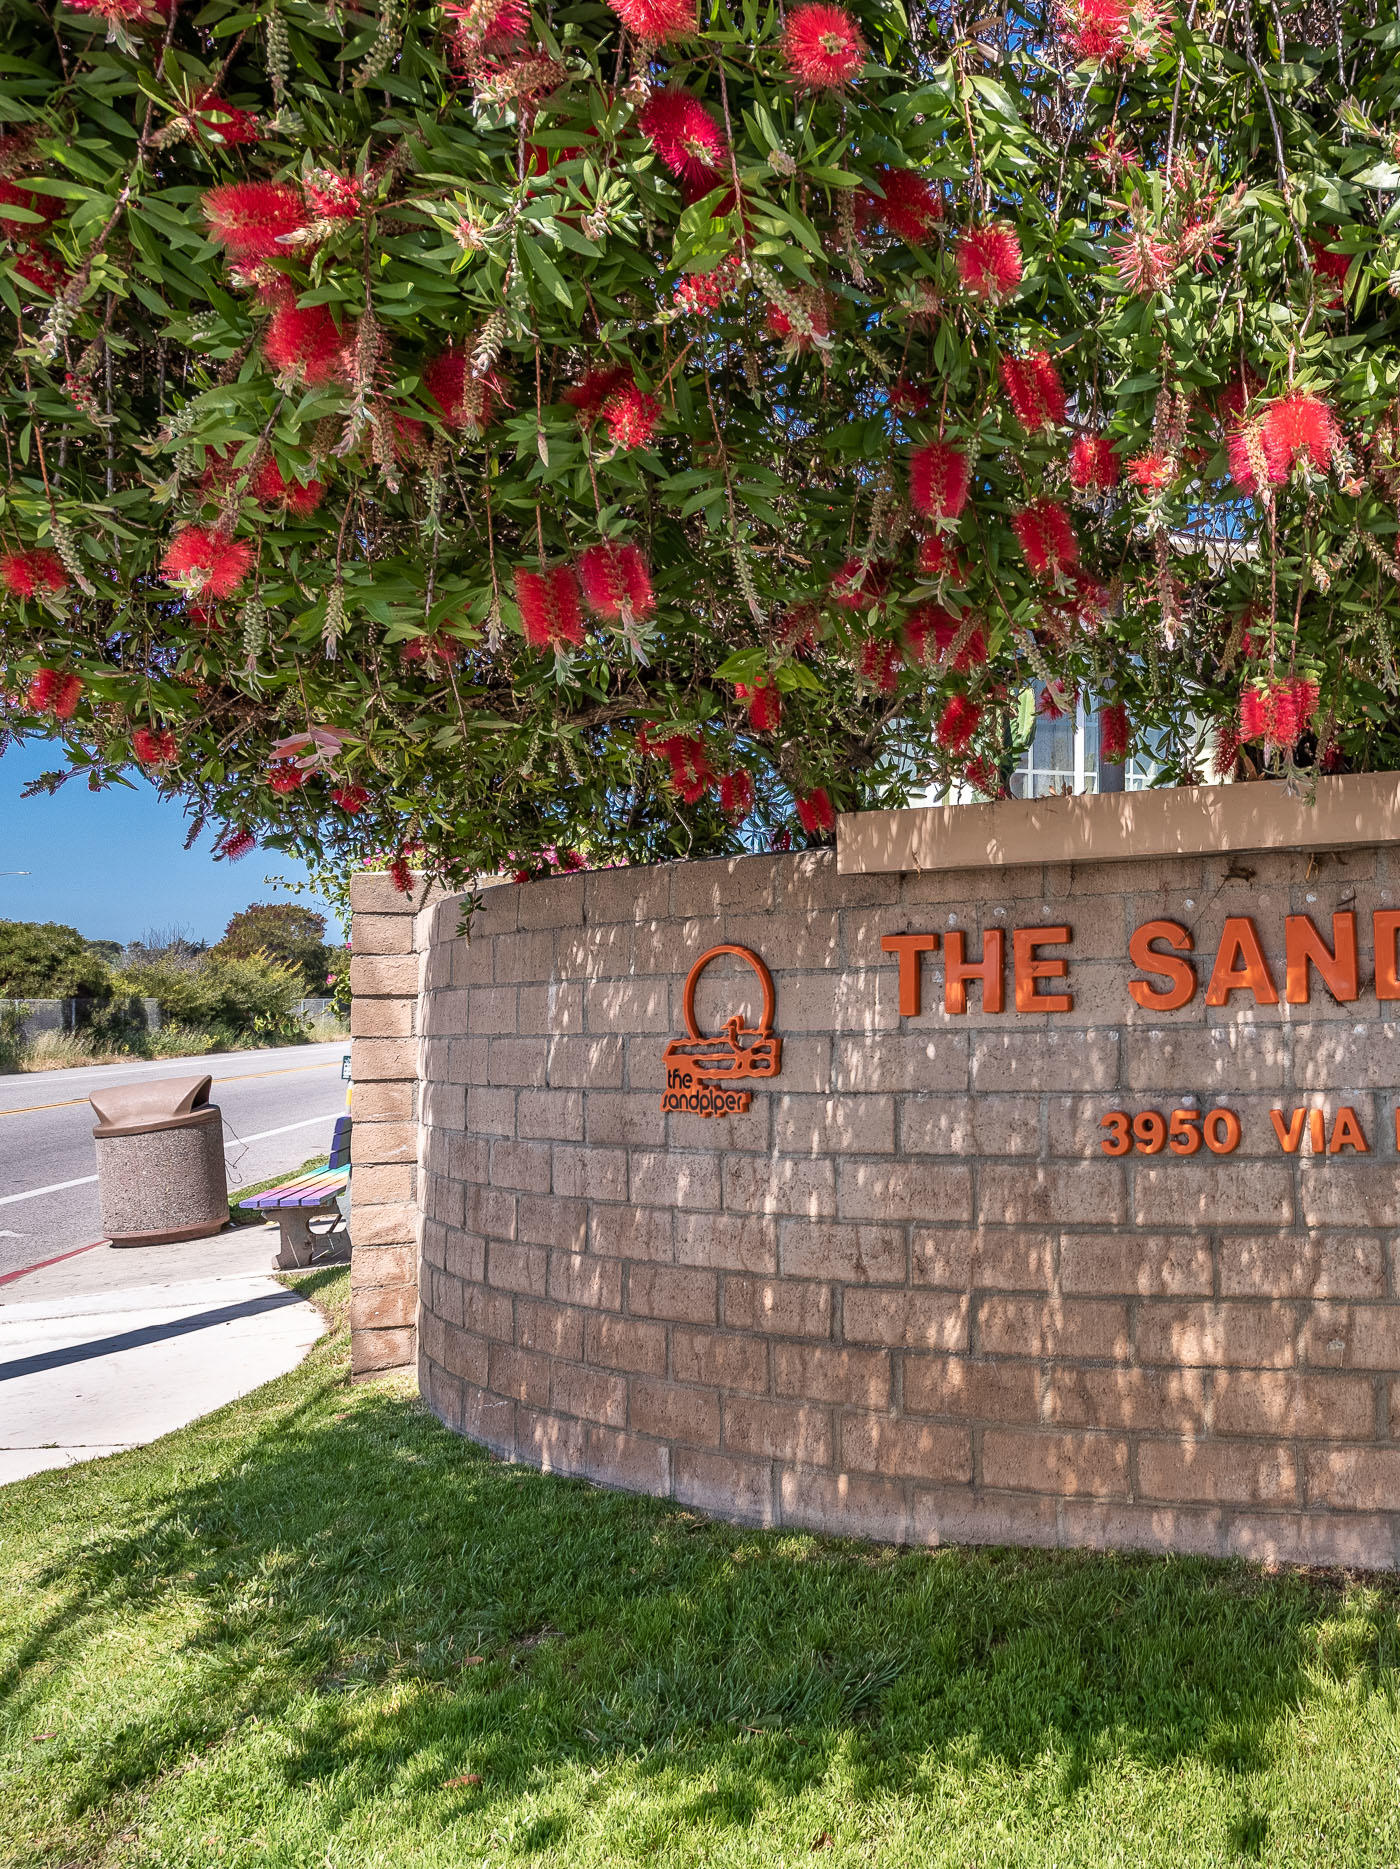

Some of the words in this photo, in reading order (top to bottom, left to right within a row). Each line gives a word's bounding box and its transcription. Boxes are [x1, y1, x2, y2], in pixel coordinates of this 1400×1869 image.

[881, 925, 1074, 1017] THE
[667, 1068, 693, 1089] the
[662, 1089, 743, 1114] sandpiper
[1101, 1108, 1242, 1156] 3950
[1270, 1106, 1370, 1154] VIA
